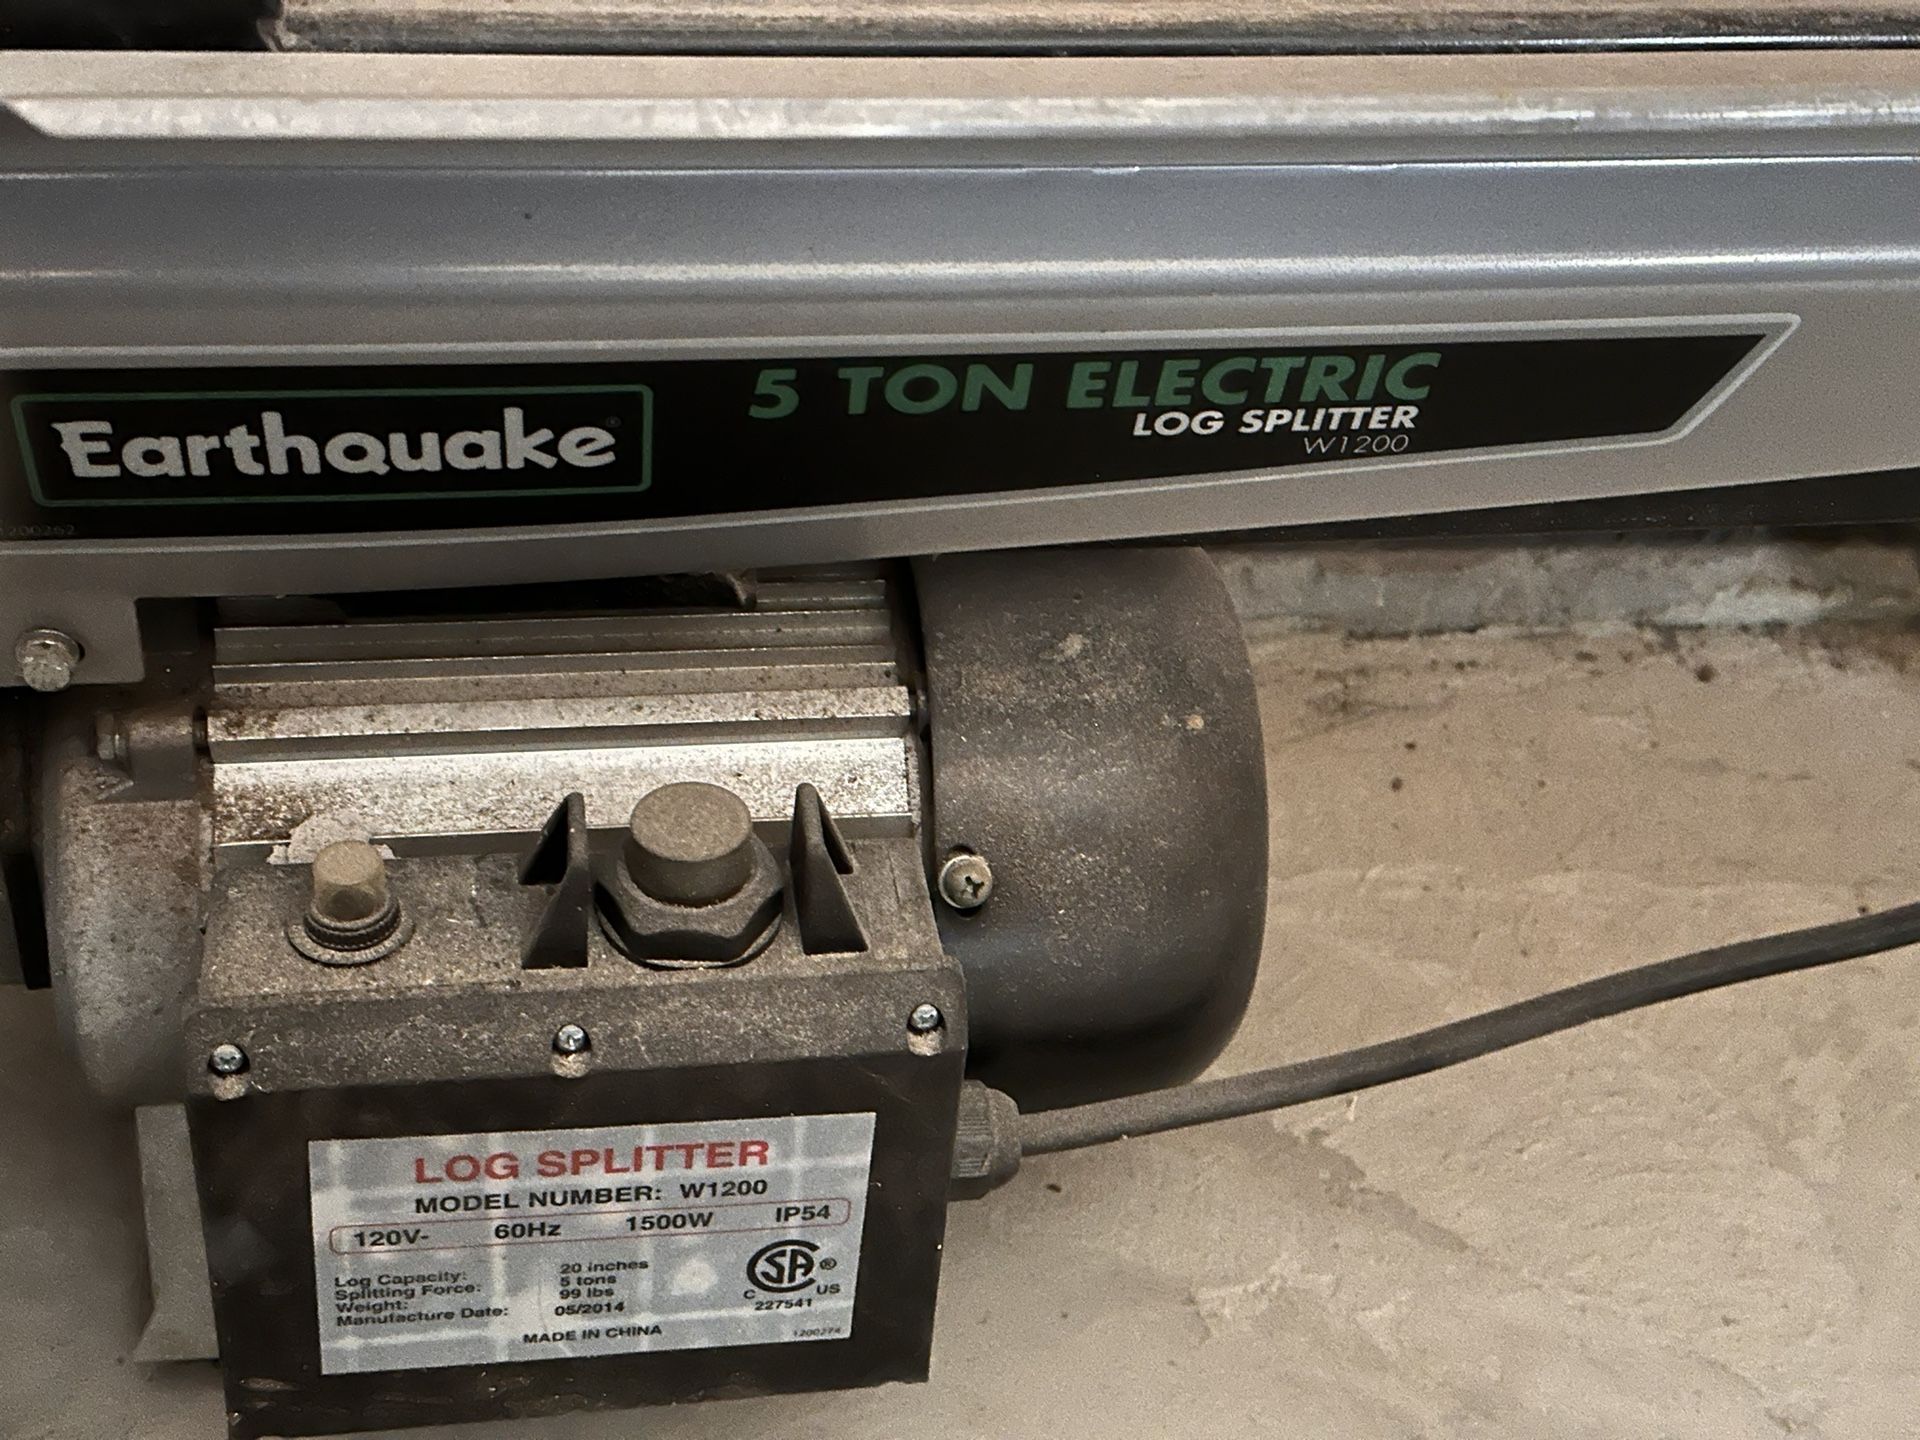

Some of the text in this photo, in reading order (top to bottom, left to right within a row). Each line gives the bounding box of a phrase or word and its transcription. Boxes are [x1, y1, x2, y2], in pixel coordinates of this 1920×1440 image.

[748, 352, 1442, 420] 5 TON ELECTRIC
[1133, 405, 1419, 437] LOG SPLITTER
[52, 406, 617, 478] Earthquake
[1303, 434, 1410, 455] W1200
[415, 1140, 770, 1184] LOG SPLITTER
[415, 1179, 768, 1214] MODEL NUMBER: W1200
[494, 1223, 562, 1240] 60Hz
[626, 1212, 713, 1232] 1500W
[775, 1205, 831, 1223] IP54
[560, 1260, 649, 1274] 20 inches
[335, 1271, 467, 1288] Log Capacity:
[560, 1274, 617, 1287] 5 tons
[335, 1283, 481, 1301] Splitting Force:
[560, 1287, 615, 1299] 99 lbs
[816, 1283, 841, 1295] US
[336, 1300, 408, 1314] Weight:
[554, 1301, 624, 1316] 05/2014
[755, 1298, 813, 1310] 227541
[337, 1306, 508, 1327] Manufacture Date:
[523, 1325, 662, 1343] MADE IN CHINA
